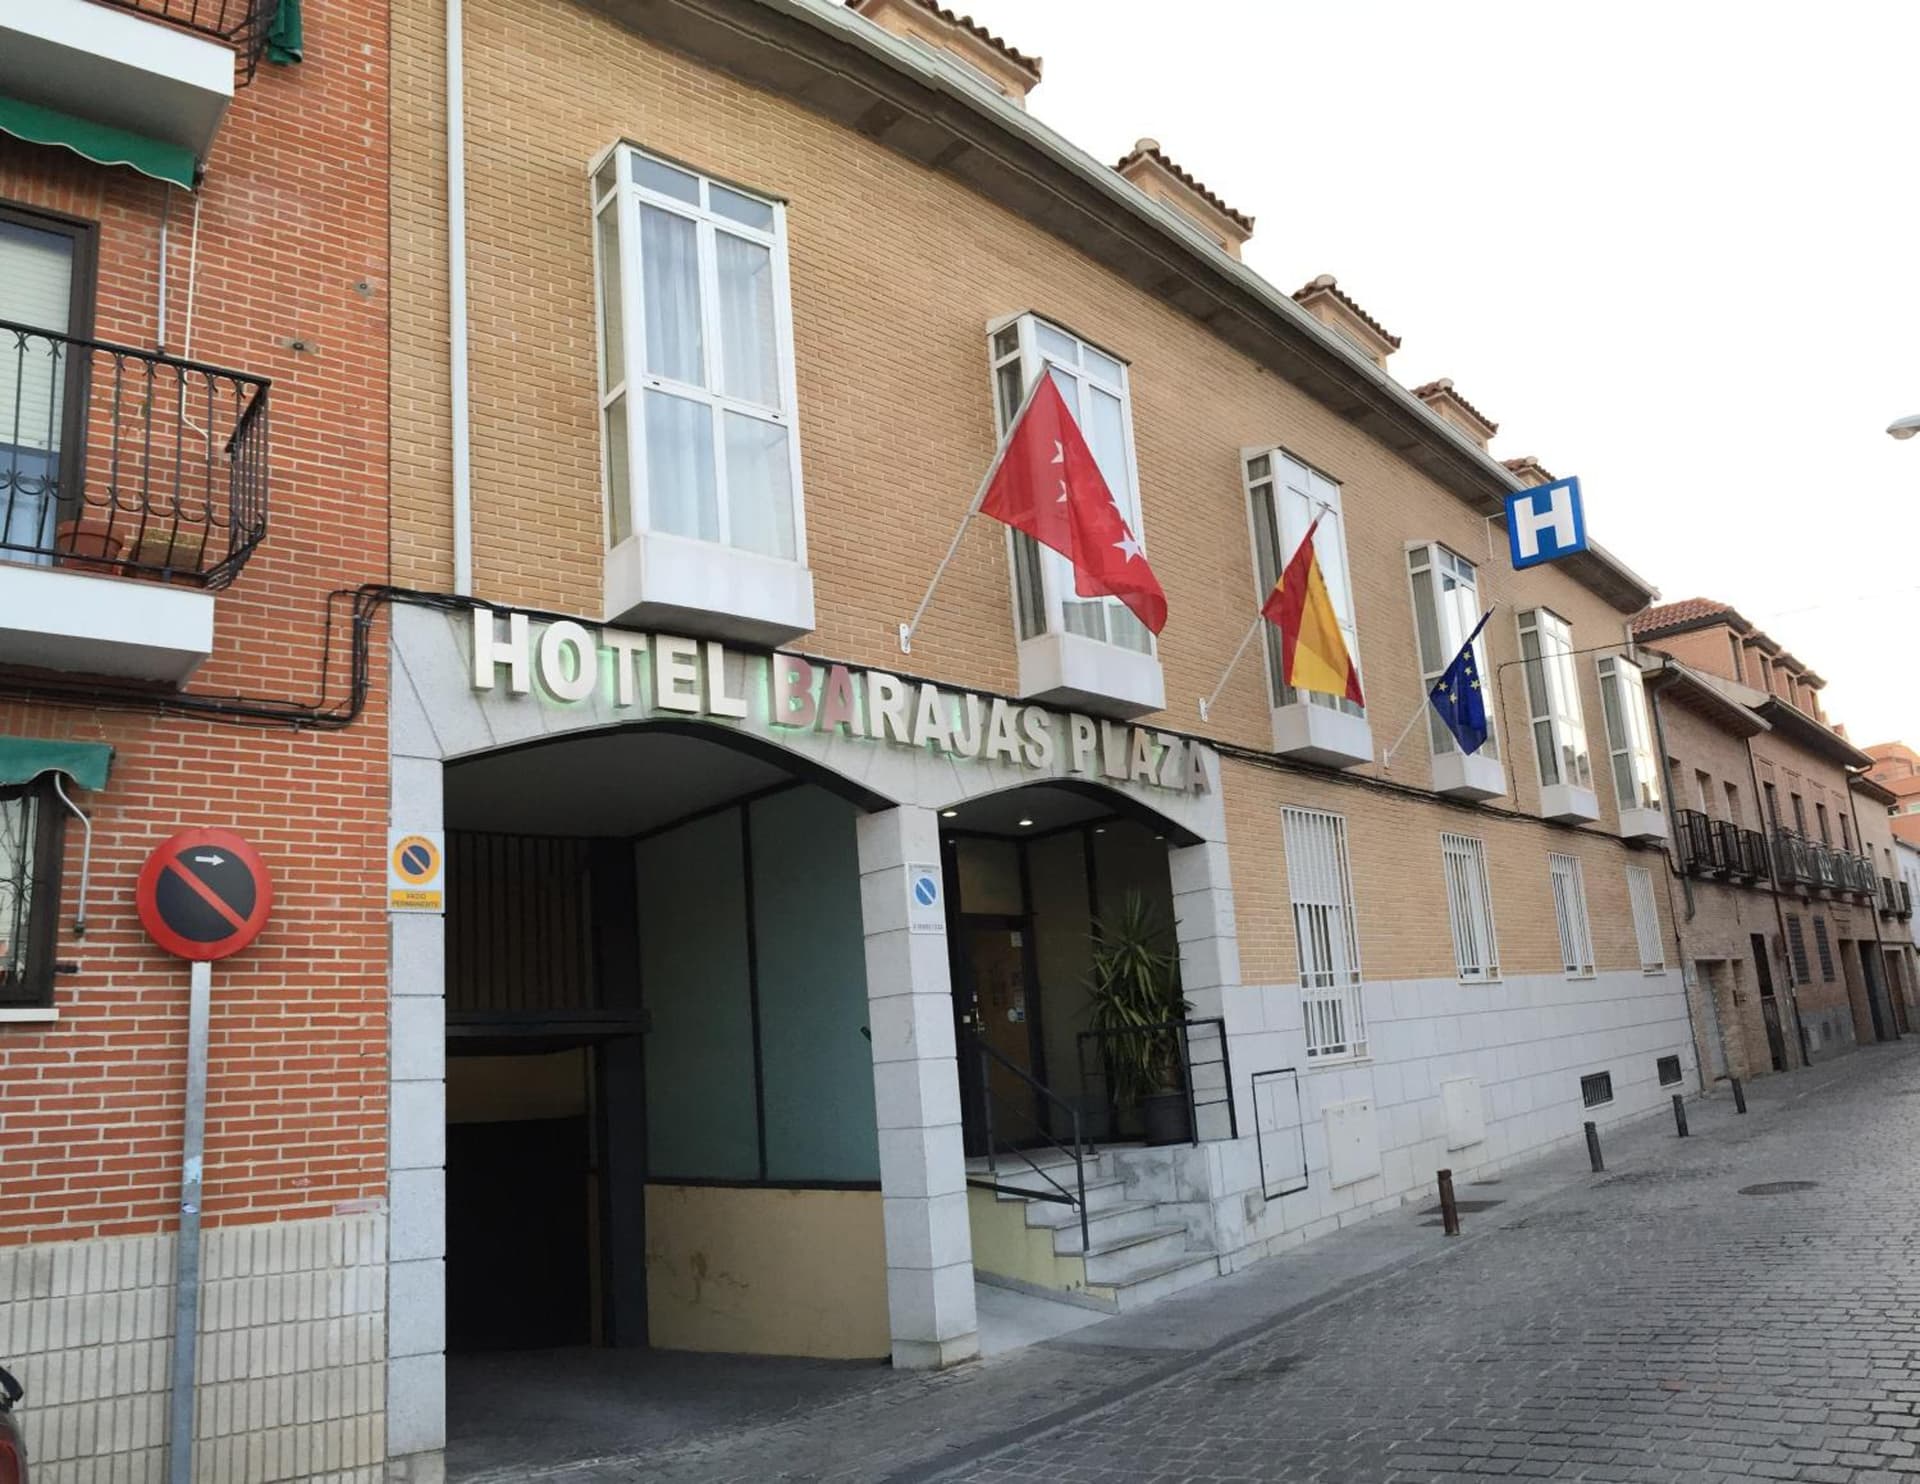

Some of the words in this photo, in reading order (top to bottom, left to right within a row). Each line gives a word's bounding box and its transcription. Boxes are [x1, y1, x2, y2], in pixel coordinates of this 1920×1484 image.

[1513, 485, 1577, 559] H
[472, 607, 747, 719] HOTEL
[772, 652, 1054, 769] BARAJAS
[1069, 712, 1211, 795] PLAZA
